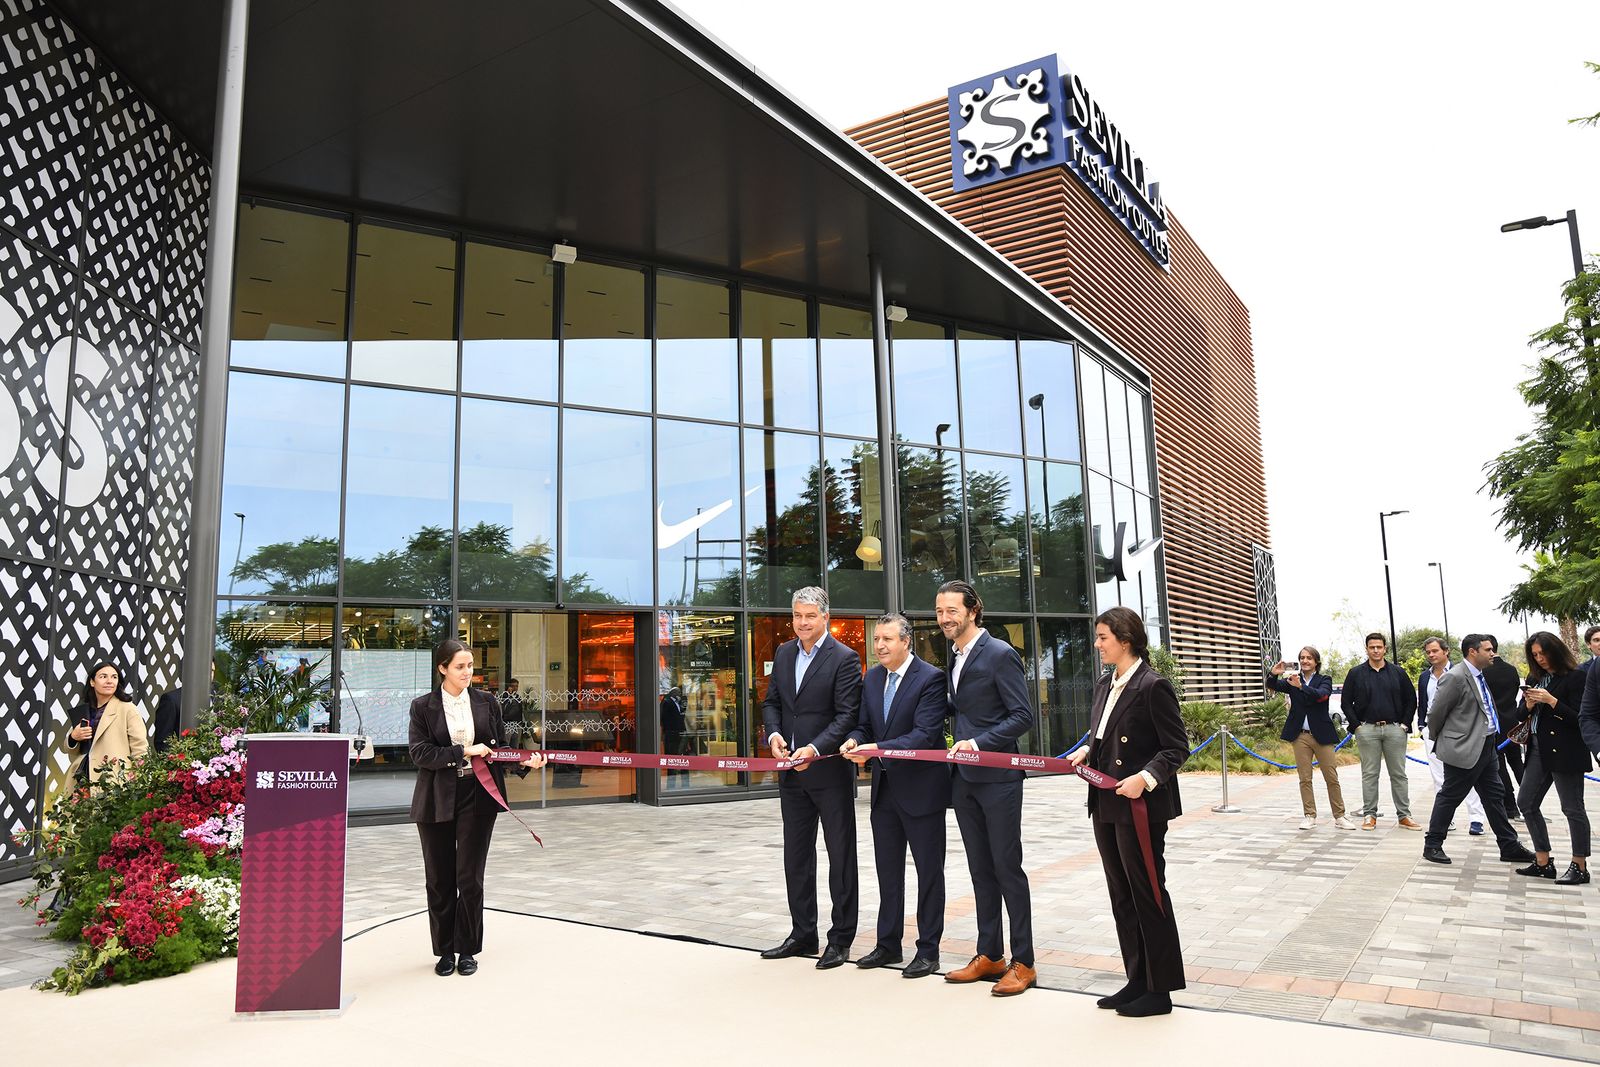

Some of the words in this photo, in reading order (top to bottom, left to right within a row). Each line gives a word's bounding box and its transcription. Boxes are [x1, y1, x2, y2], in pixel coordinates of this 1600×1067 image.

[1071, 73, 1169, 227] SEVILLA
[1072, 134, 1131, 218] FASHION
[1132, 204, 1171, 275] OUTLET
[278, 771, 337, 781] SEVILLA
[1082, 767, 1103, 782] SEVILLA
